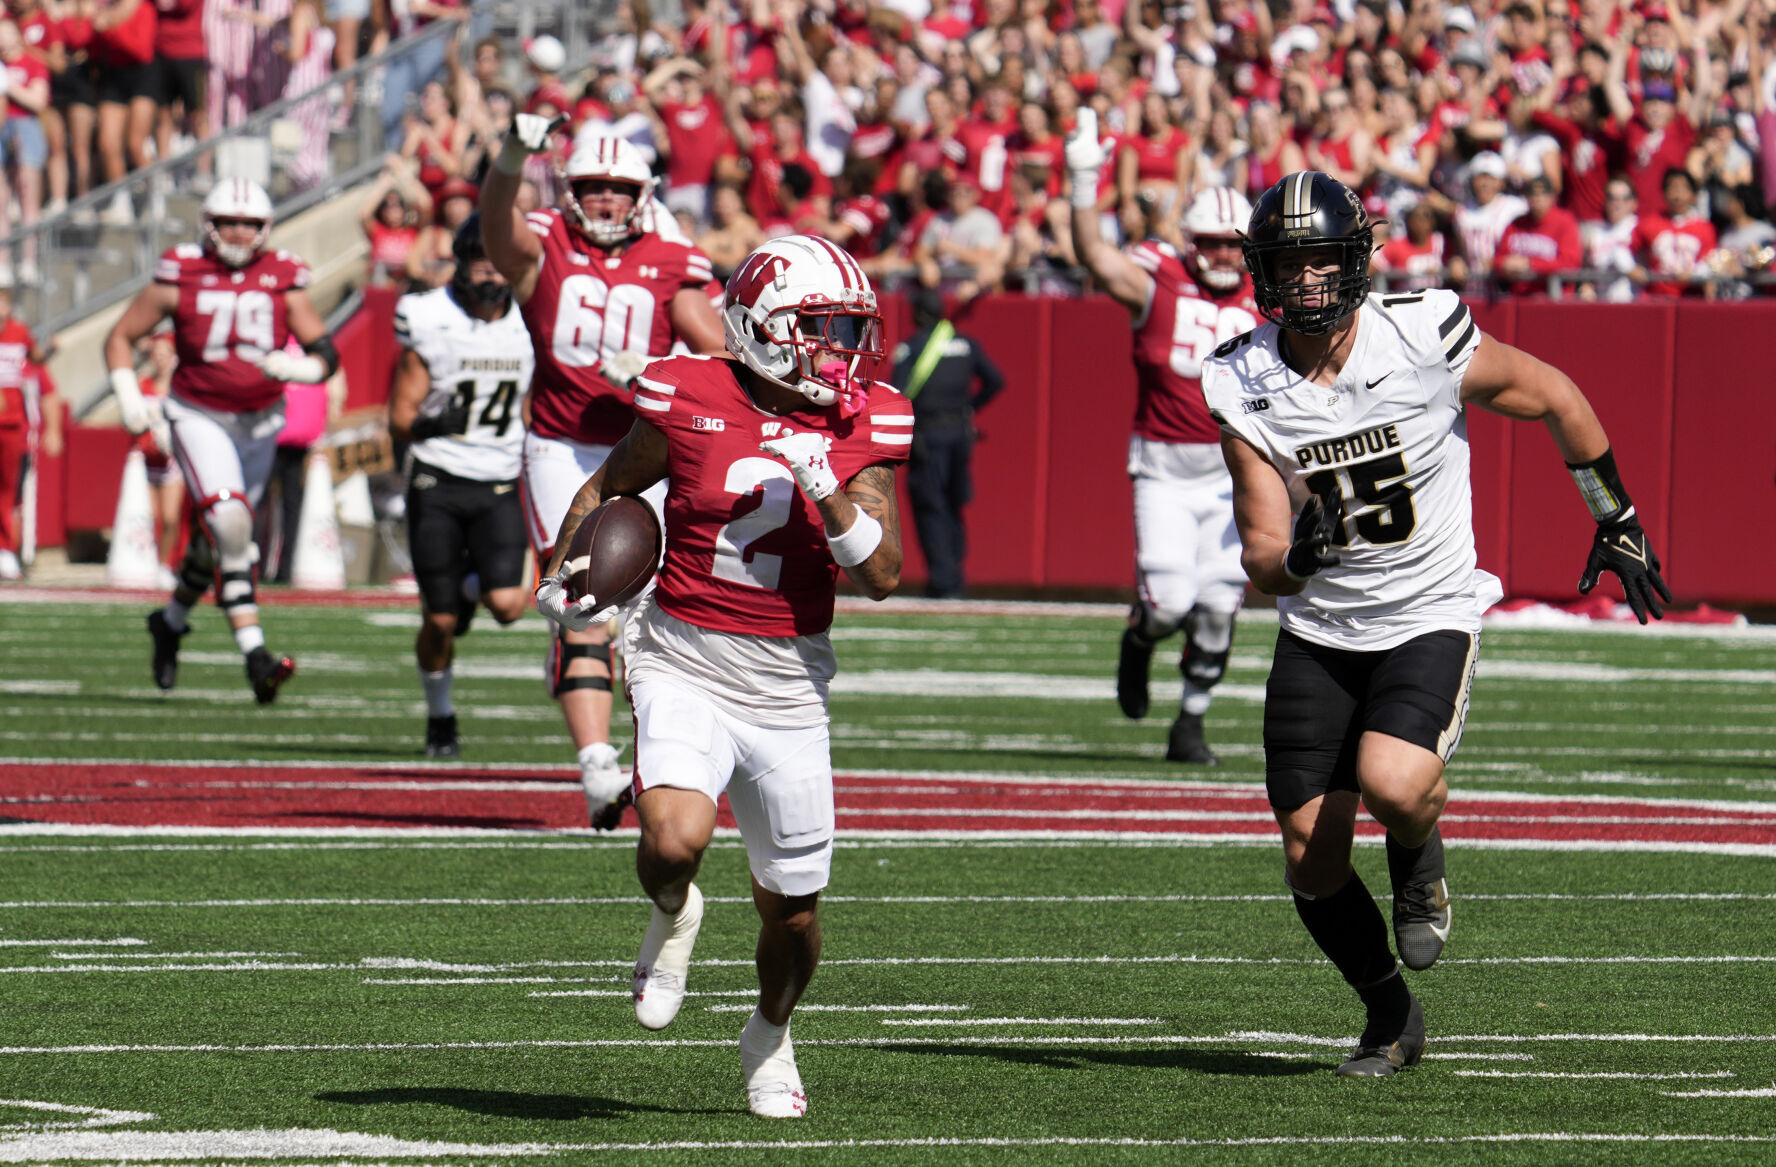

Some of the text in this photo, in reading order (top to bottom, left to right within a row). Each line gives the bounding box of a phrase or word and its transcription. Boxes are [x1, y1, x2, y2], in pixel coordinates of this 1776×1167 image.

[196, 290, 274, 363] 79
[553, 274, 655, 367] 60
[454, 379, 518, 437] 14
[1295, 424, 1401, 469] PURDUE
[711, 456, 795, 590] 2
[1305, 451, 1419, 550] 15
